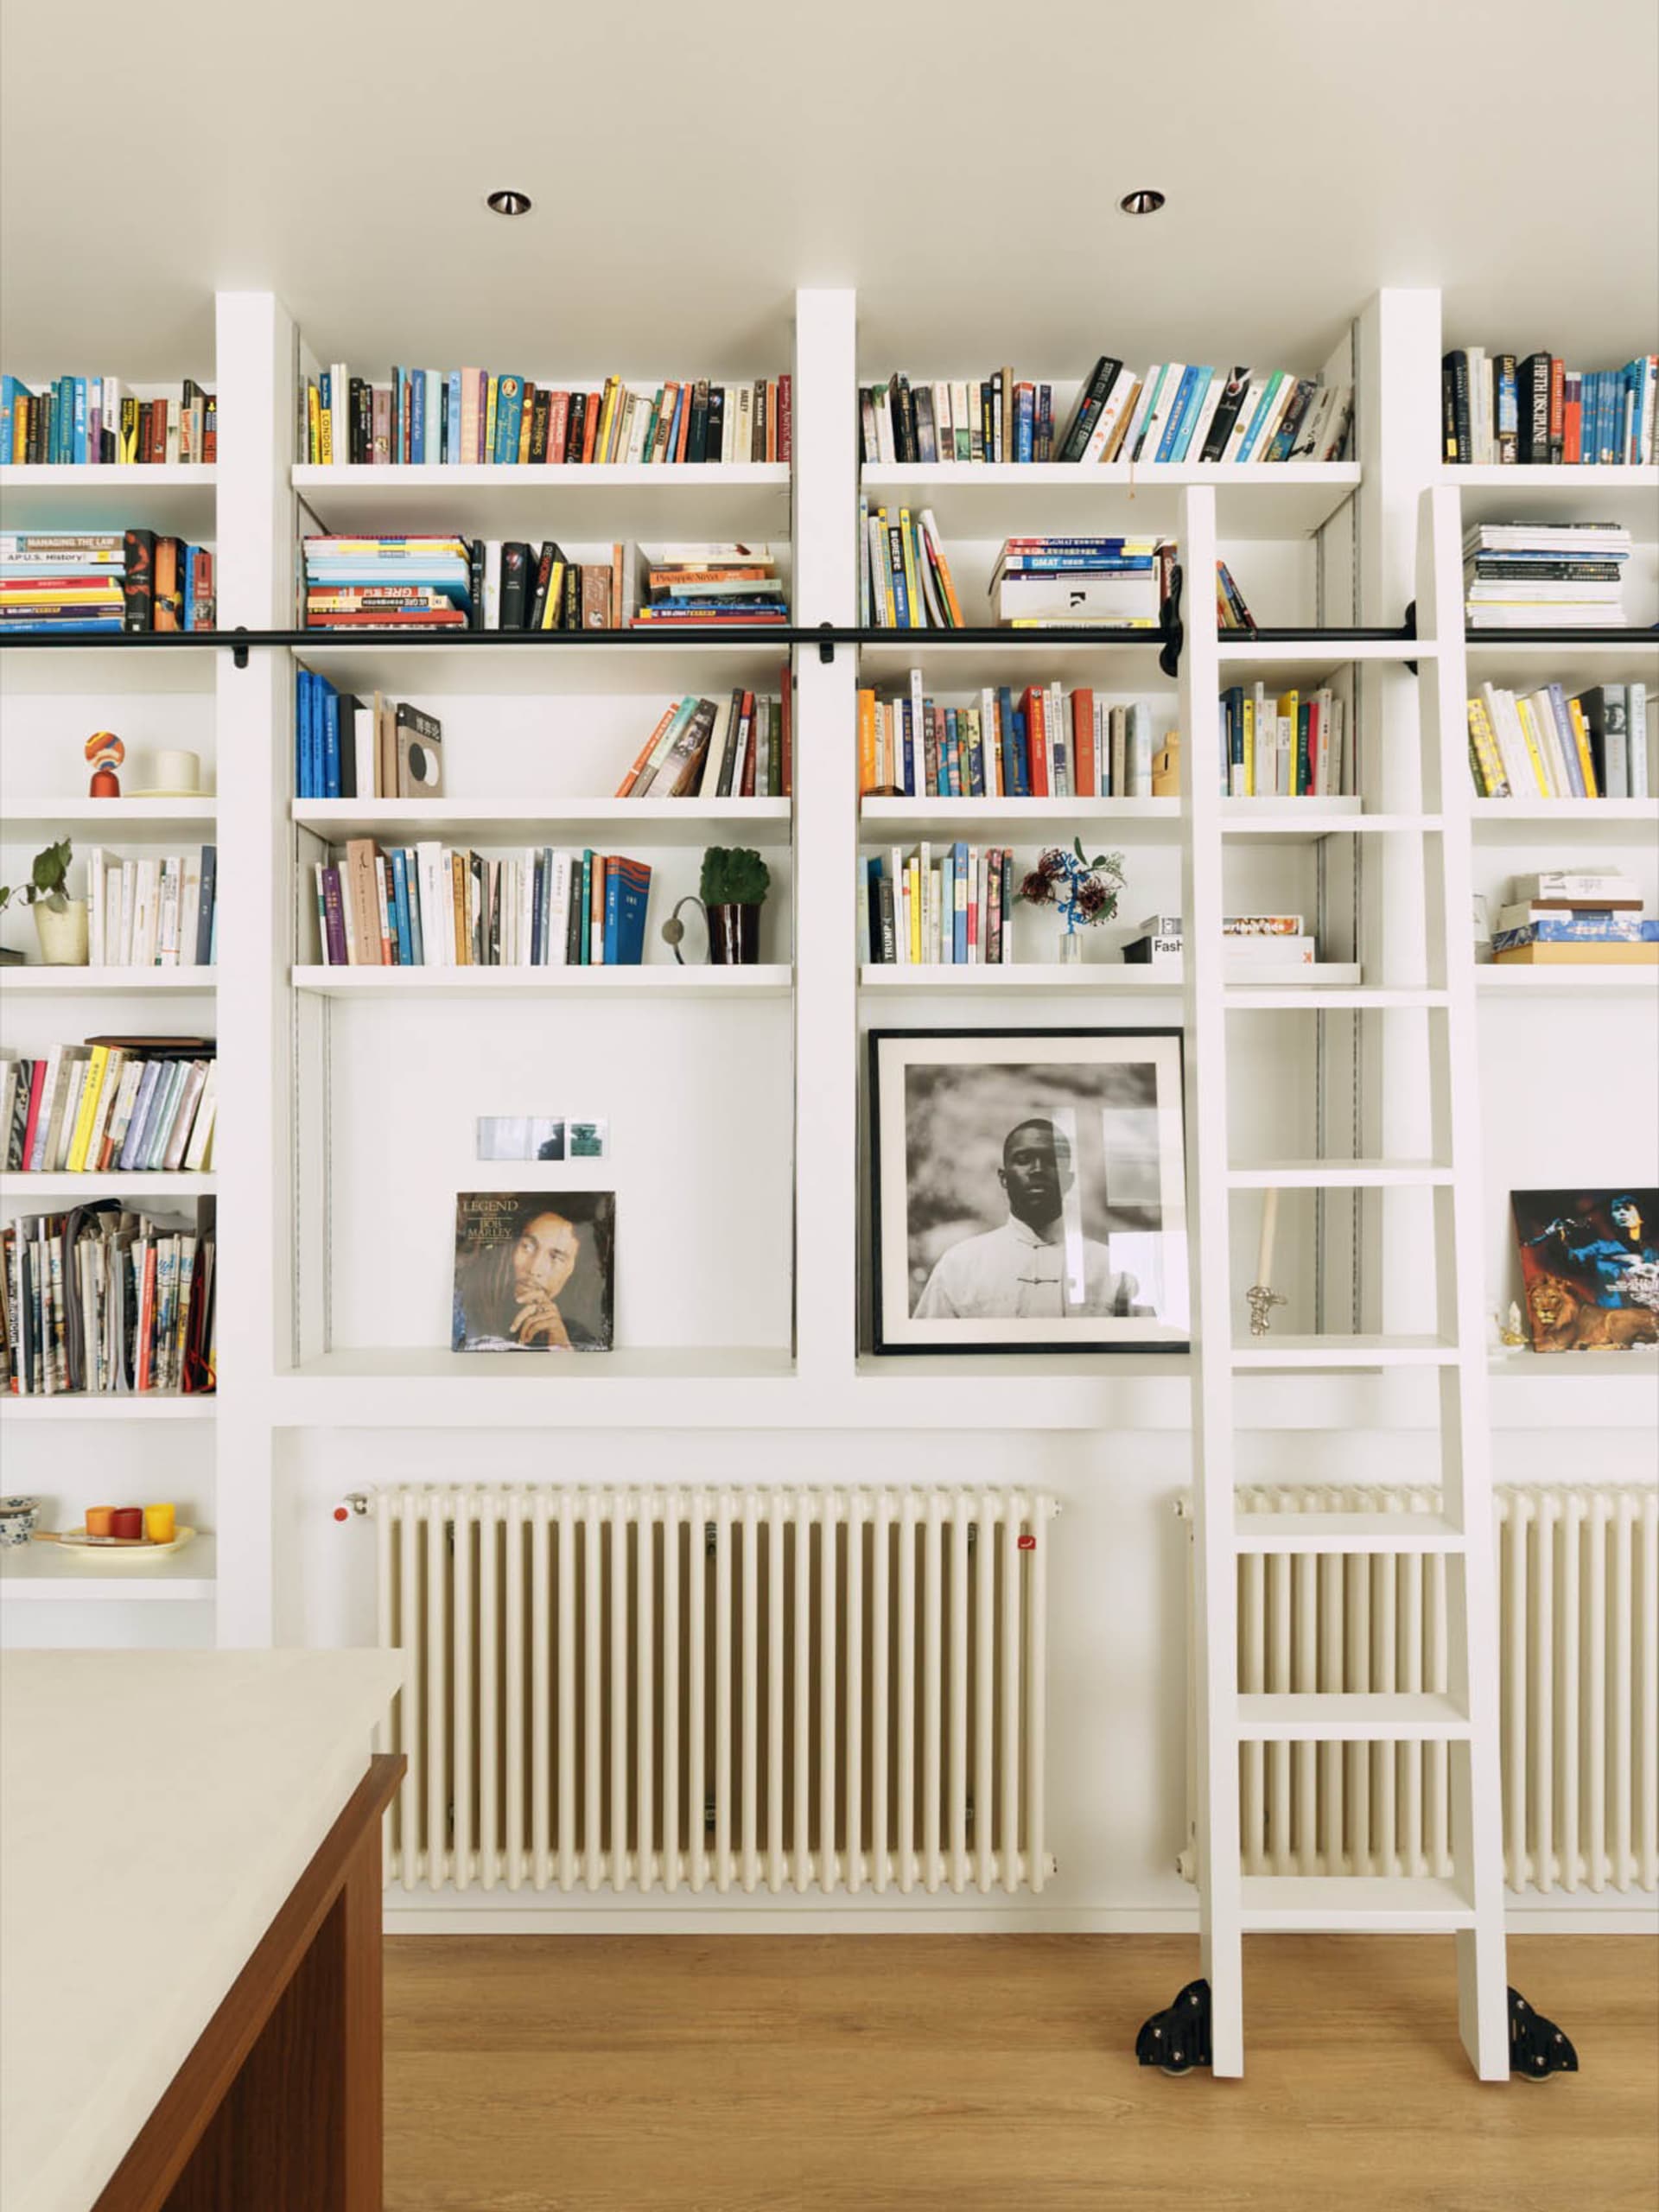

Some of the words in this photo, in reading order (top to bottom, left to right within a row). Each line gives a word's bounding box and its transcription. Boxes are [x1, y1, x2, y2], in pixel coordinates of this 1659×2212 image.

[1534, 365, 1548, 391] FIFTH
[322, 414, 331, 456] LONDON
[1533, 393, 1548, 443] DISCIPLINE
[539, 545, 552, 584] REWORK
[883, 925, 893, 960] TRUMP
[462, 1200, 519, 1211] LEGEND
[467, 1228, 512, 1237] MARLEY
